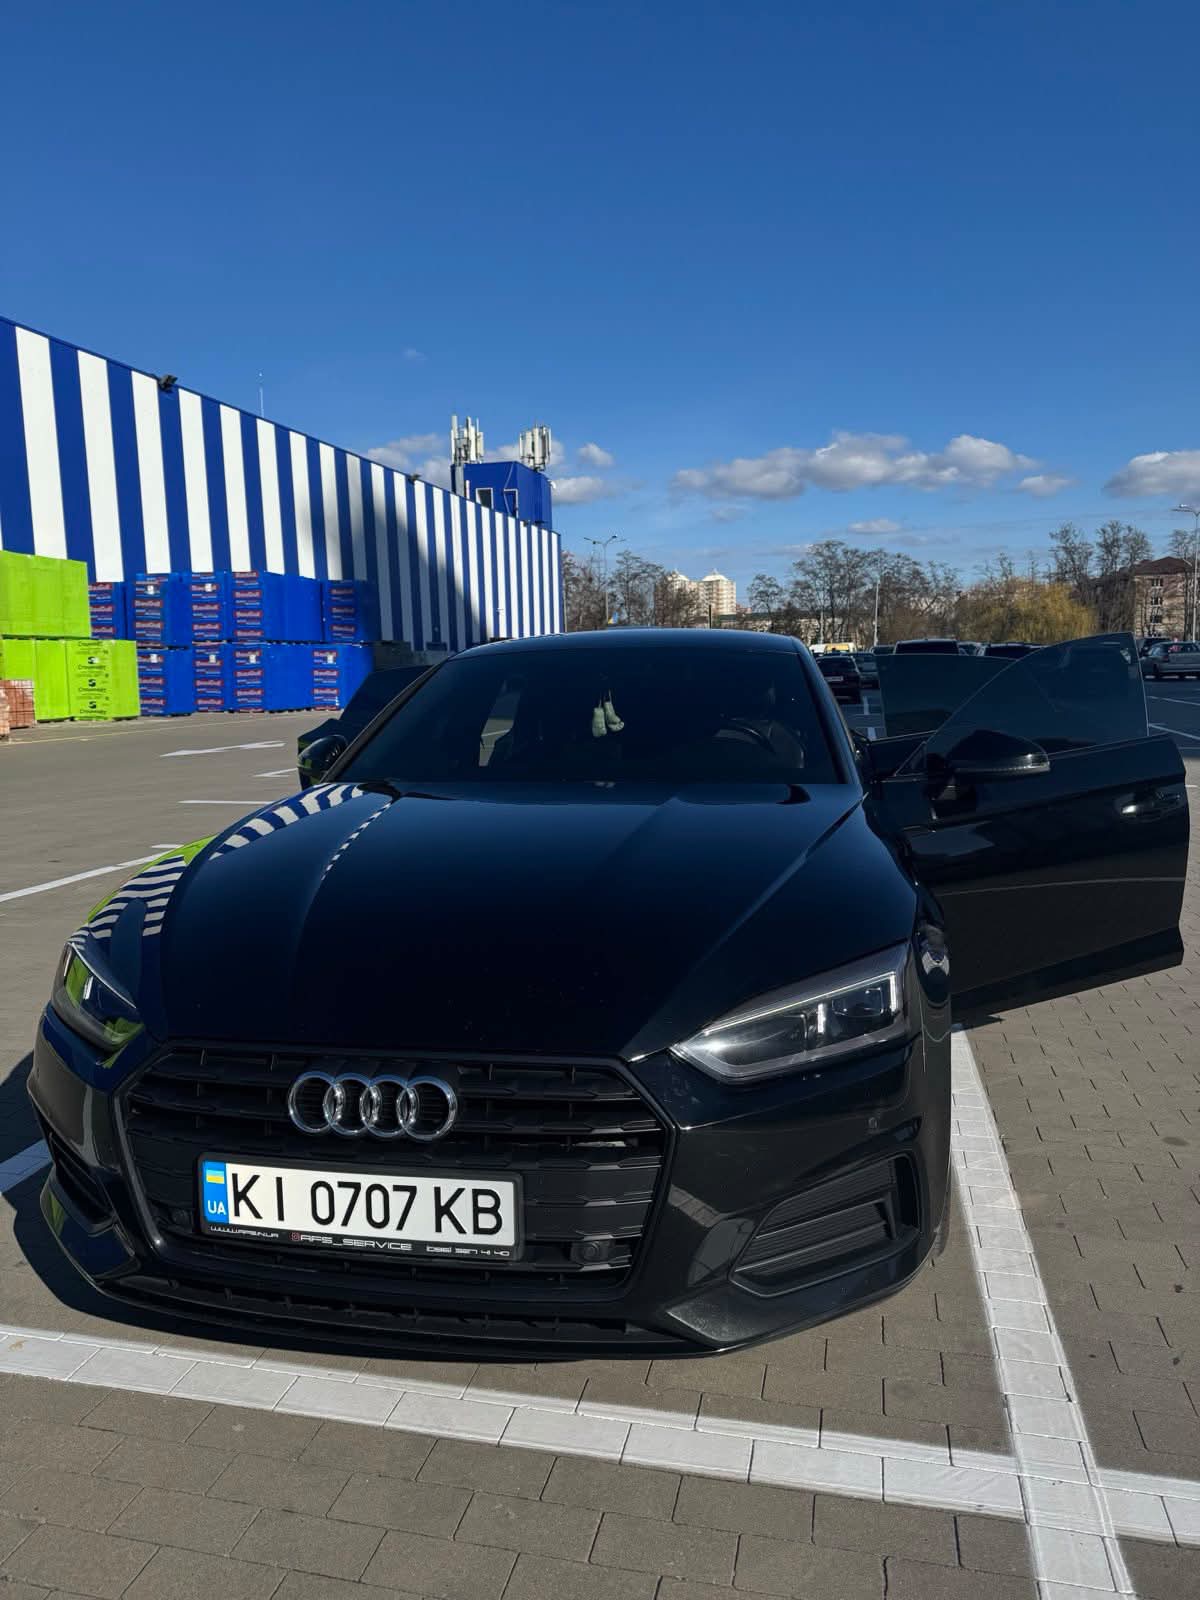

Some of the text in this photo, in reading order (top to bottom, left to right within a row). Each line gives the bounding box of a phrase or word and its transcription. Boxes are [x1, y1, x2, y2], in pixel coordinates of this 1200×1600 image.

[207, 1199, 227, 1216] UA
[231, 1172, 503, 1236] KI 0707 KB
